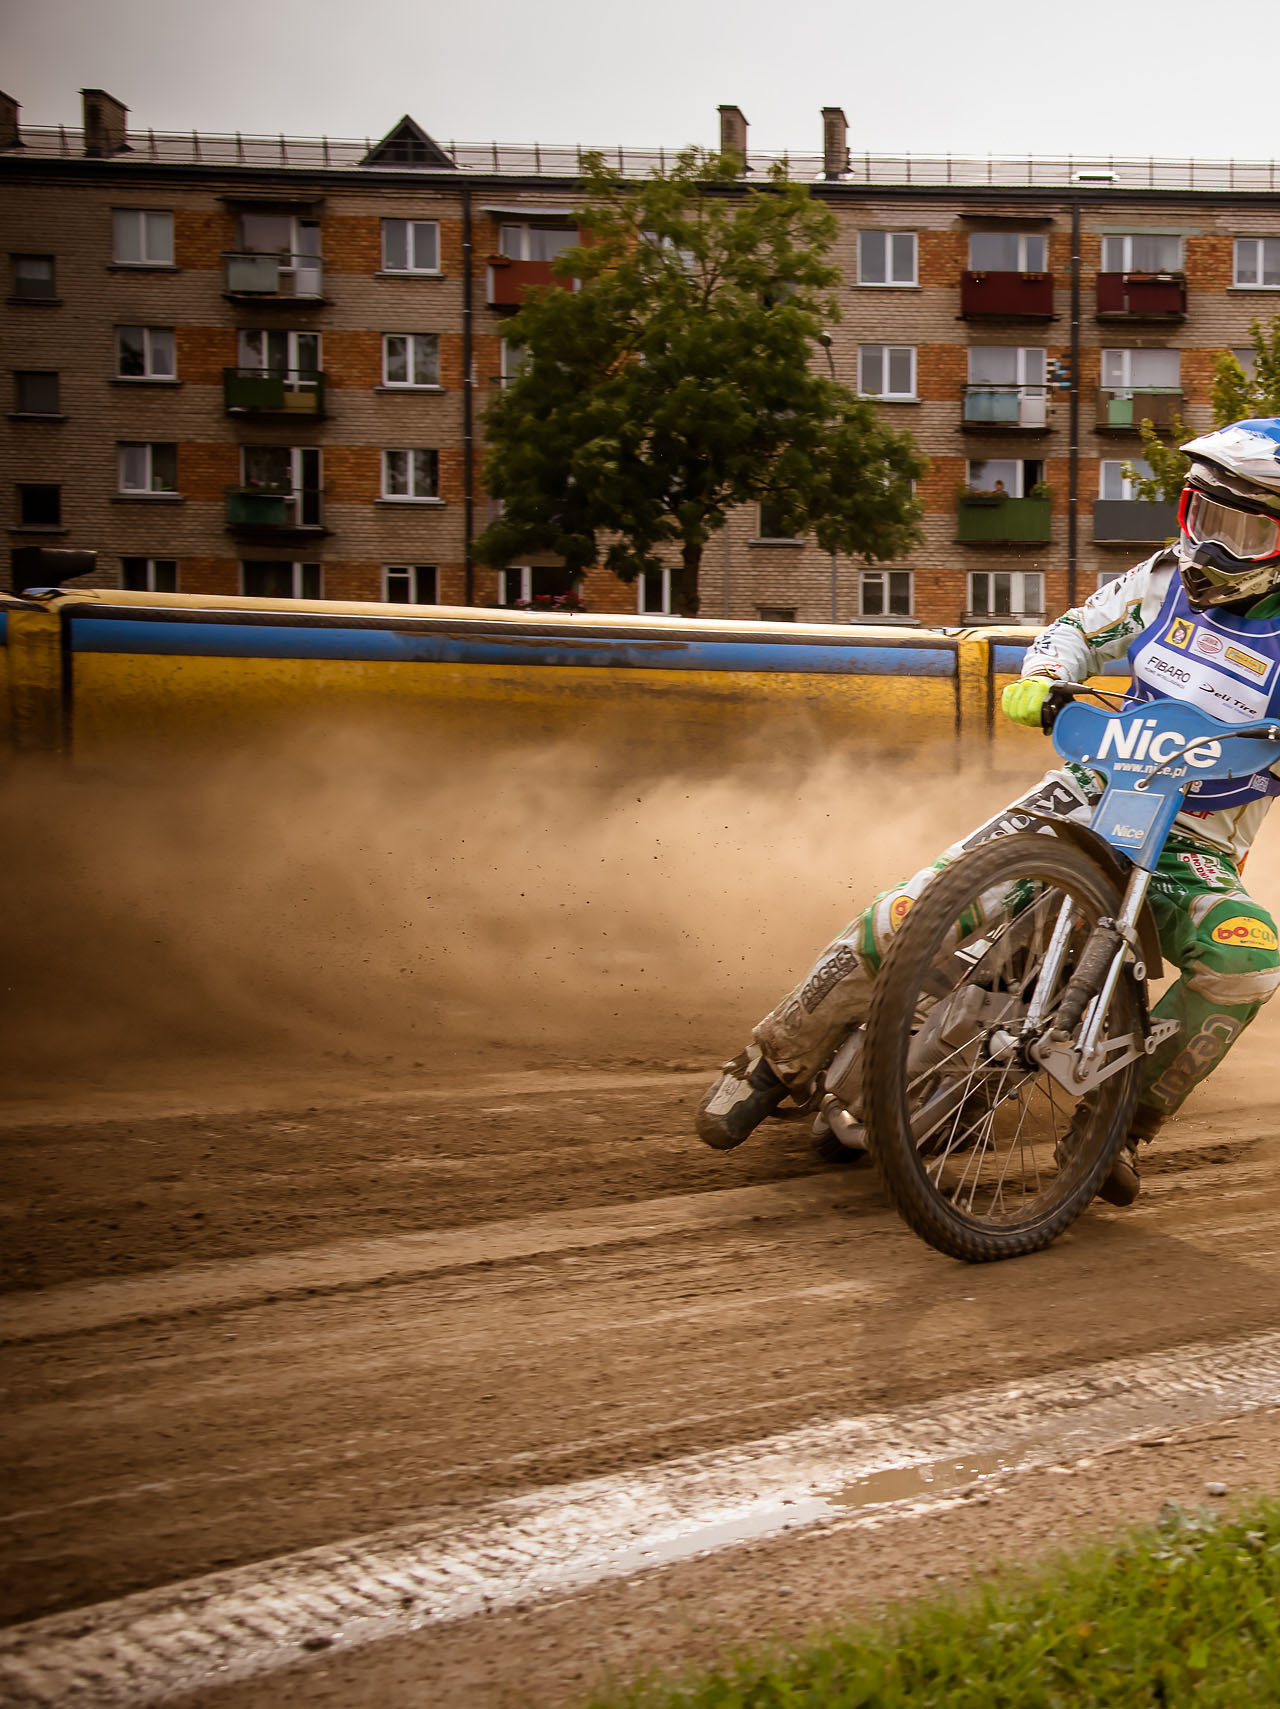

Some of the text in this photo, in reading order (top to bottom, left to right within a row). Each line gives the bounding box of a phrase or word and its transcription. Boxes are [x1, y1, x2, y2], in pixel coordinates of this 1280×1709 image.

[1147, 656, 1191, 684] FIBARO
[1199, 682, 1231, 702] Deli
[1233, 699, 1258, 716] Tire
[1096, 718, 1223, 769] Nice
[1113, 762, 1188, 779] www.nice.pl
[1111, 823, 1145, 839] Nice
